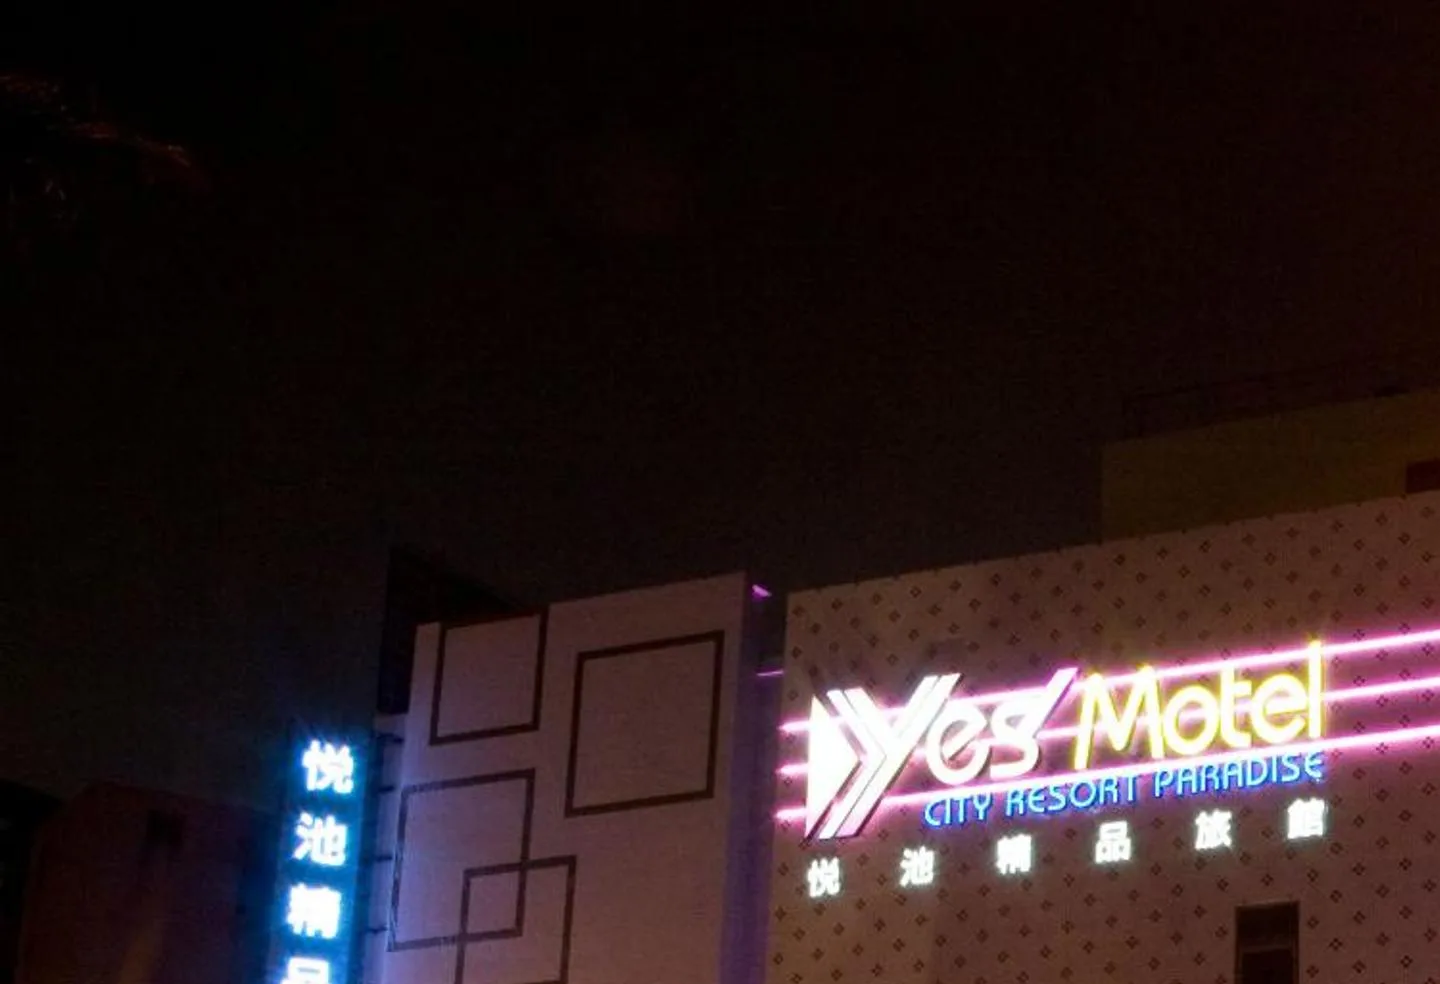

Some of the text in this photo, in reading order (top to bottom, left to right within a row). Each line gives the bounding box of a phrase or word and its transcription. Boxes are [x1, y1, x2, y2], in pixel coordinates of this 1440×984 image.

[815, 640, 1322, 839] Yes Motel
[923, 751, 1326, 829] CITY RESORT PARADISE
